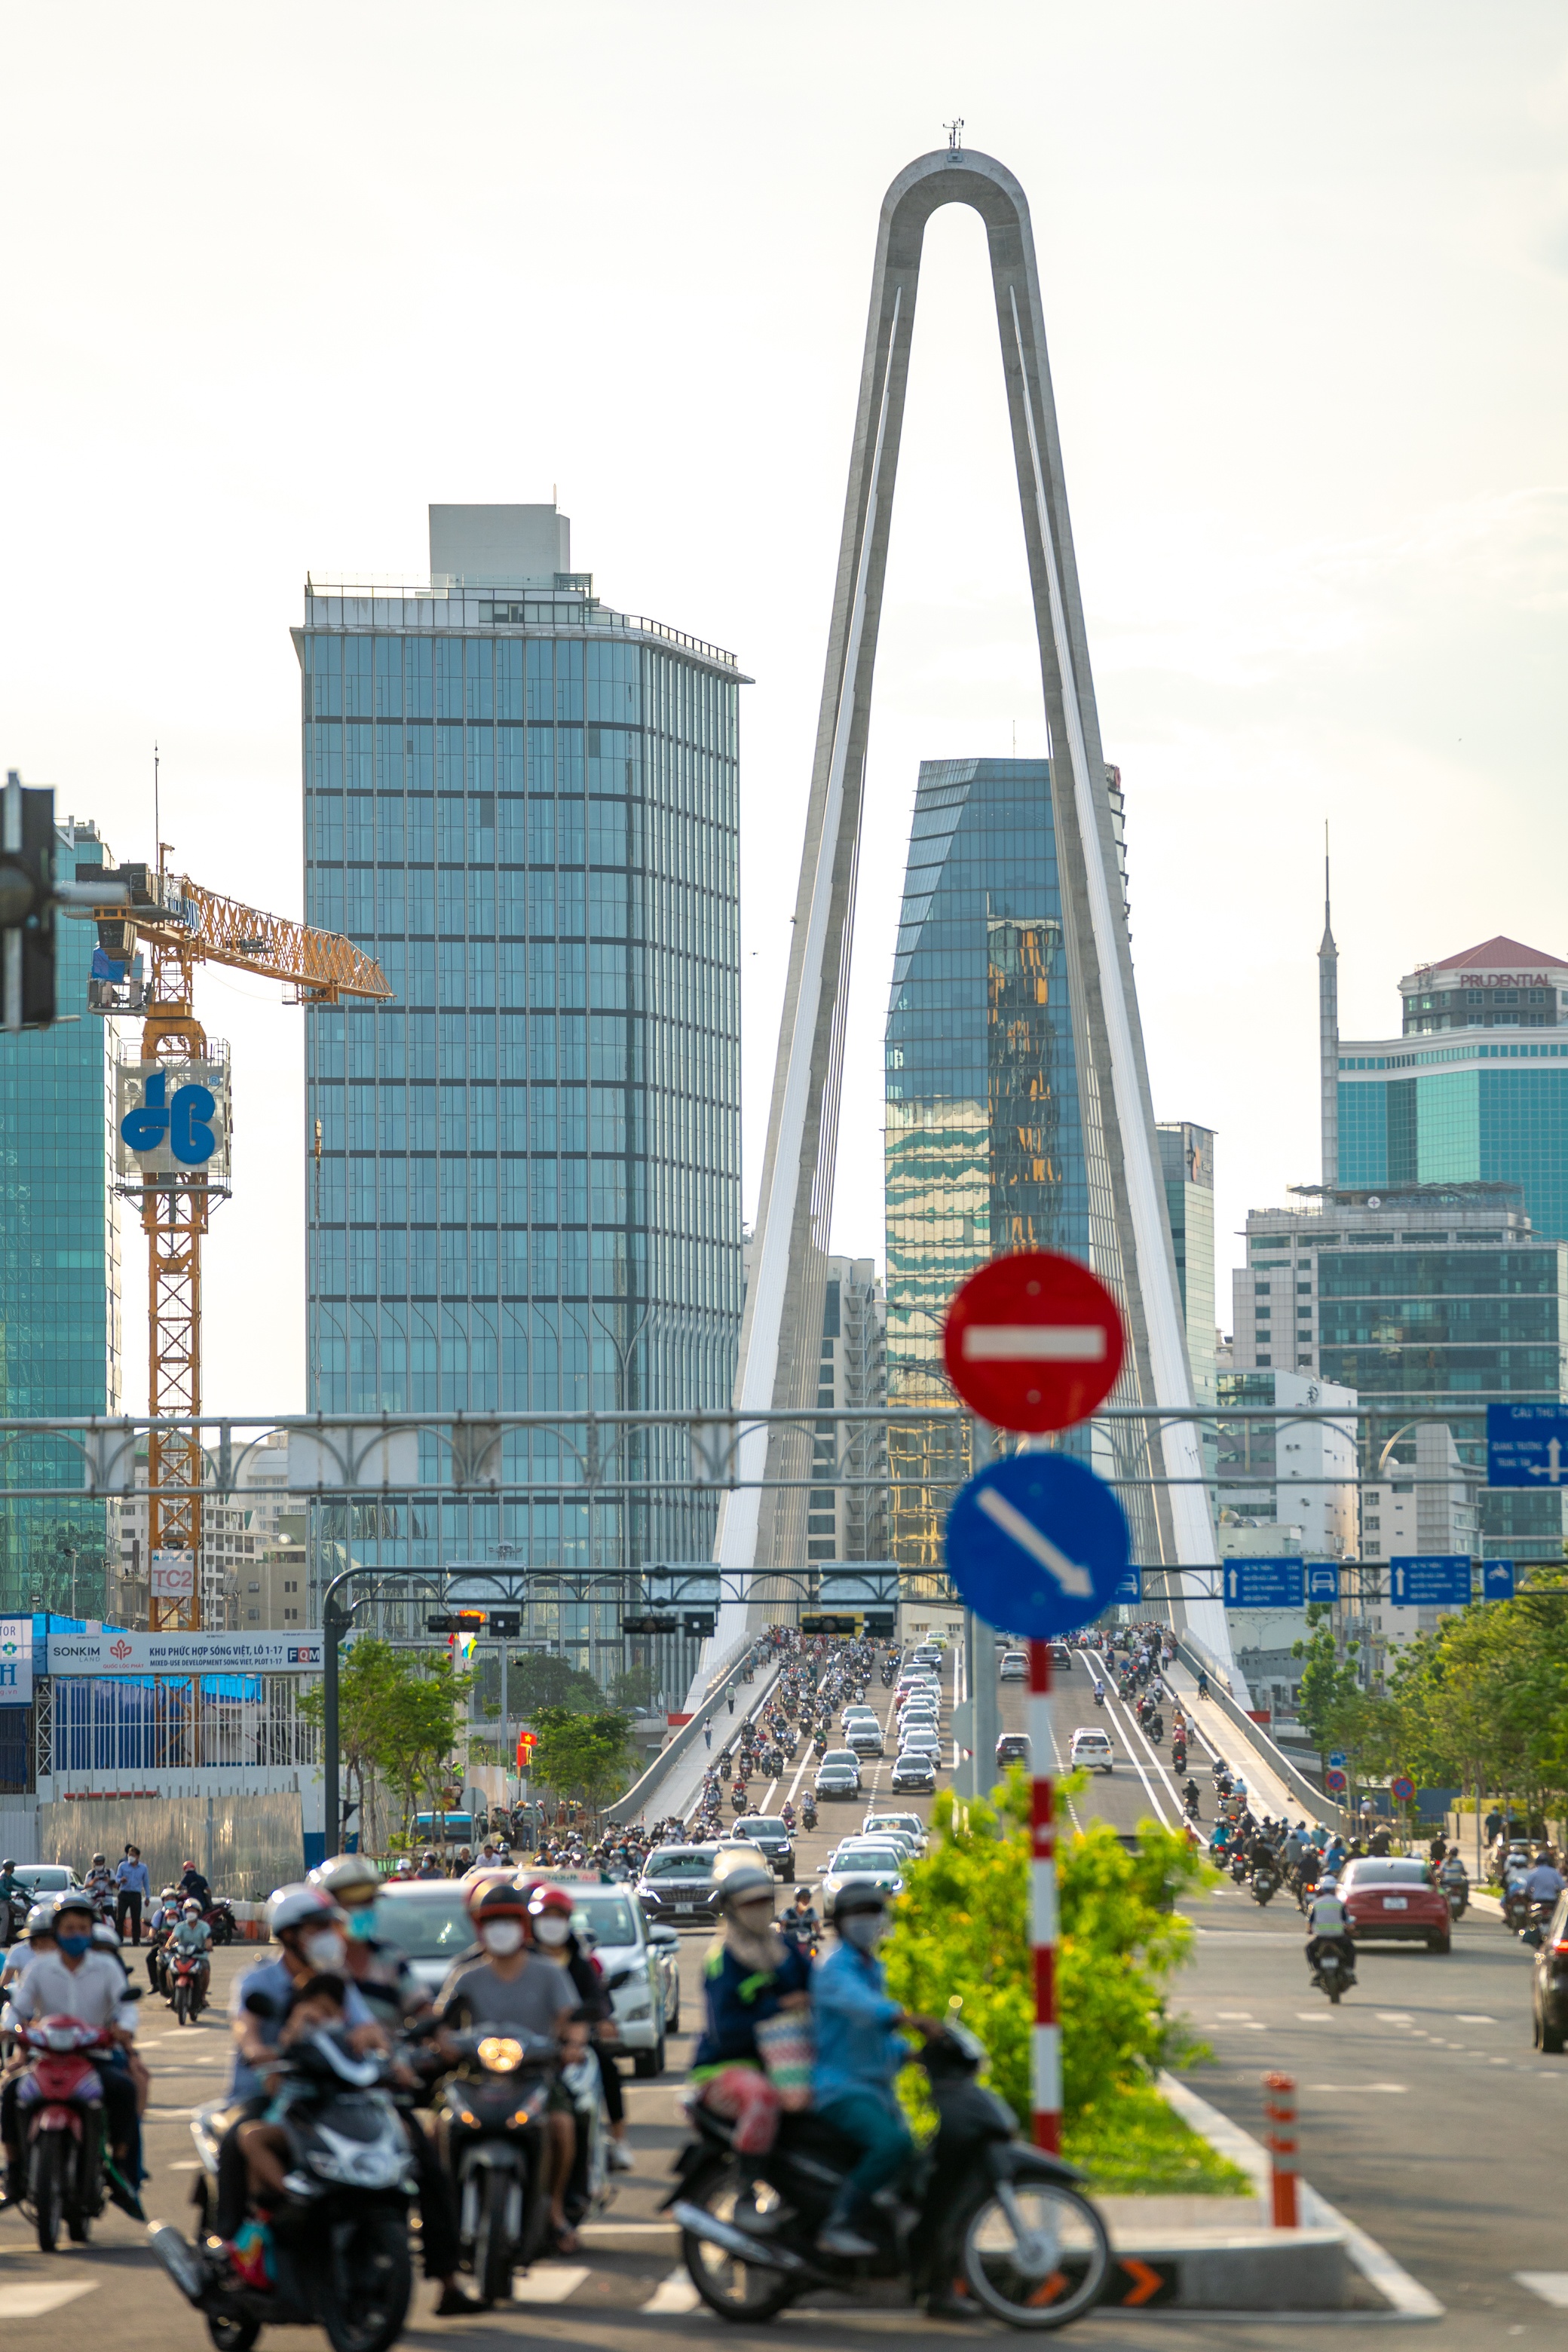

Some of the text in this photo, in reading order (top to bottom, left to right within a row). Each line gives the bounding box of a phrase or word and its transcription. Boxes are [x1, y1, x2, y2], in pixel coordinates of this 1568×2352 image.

[1460, 973, 1551, 988] PRUDENTIAL
[153, 1570, 192, 1587] TC2
[54, 1646, 100, 1656] SONKIM
[149, 1644, 283, 1658] KHU PHỨC HỢP SÓNG VIỆT, LÔ 1-17
[289, 1649, 320, 1661] FQM
